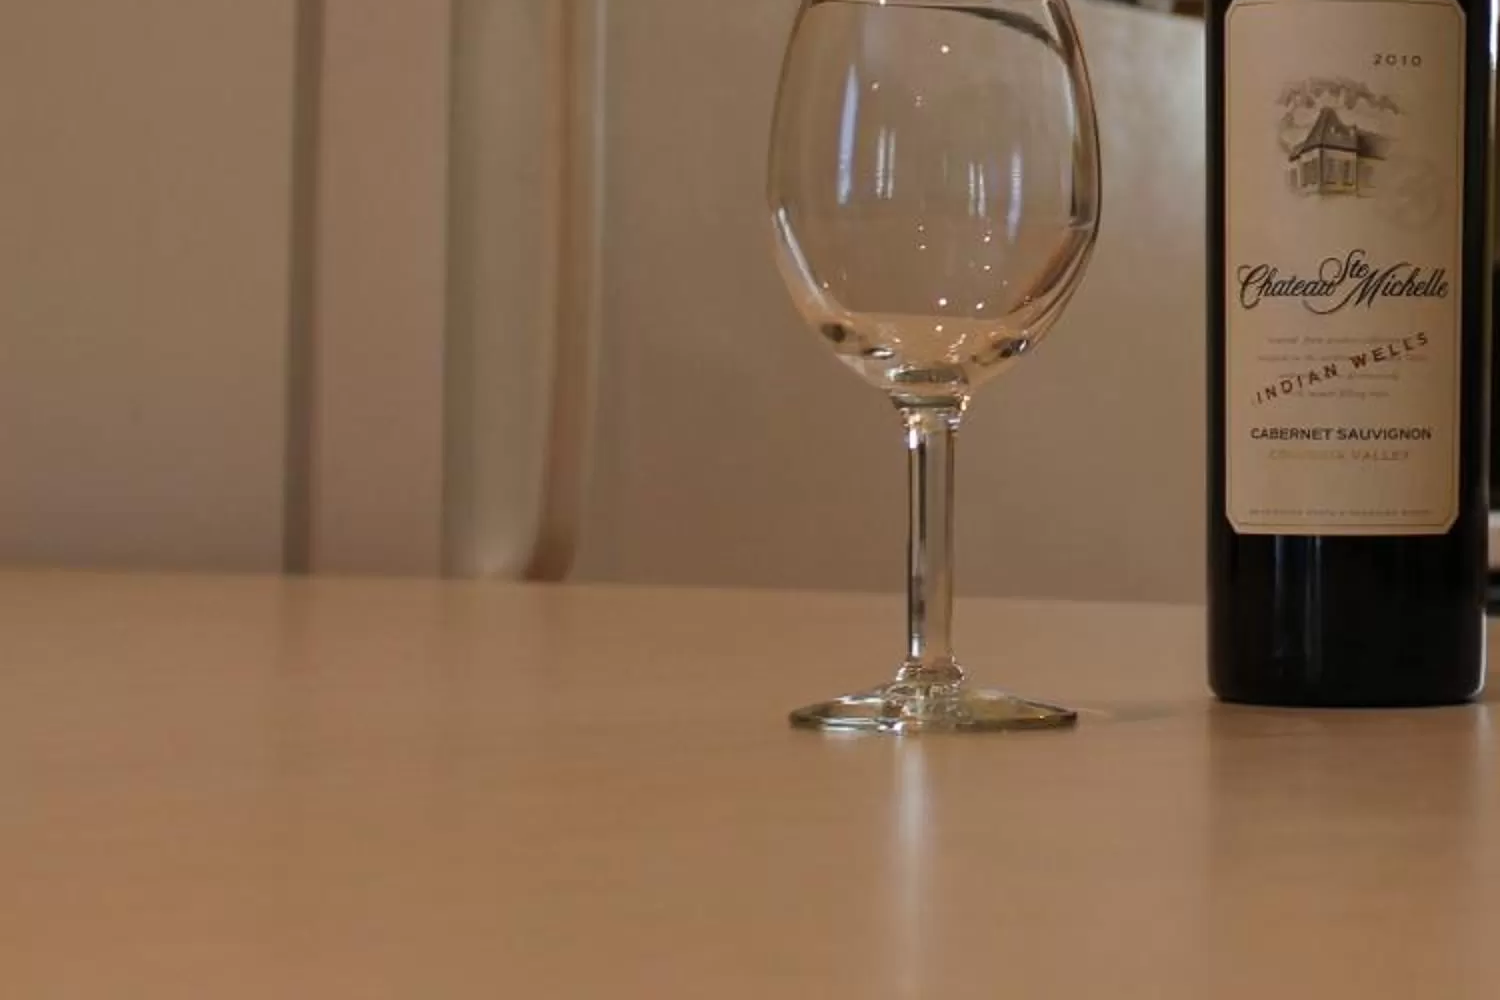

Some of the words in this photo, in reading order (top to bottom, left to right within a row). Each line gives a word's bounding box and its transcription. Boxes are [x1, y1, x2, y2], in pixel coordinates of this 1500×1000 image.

[1373, 53, 1422, 67] 2010
[1237, 264, 1338, 310] Chateau
[1303, 261, 1449, 315] Michelle
[1319, 249, 1370, 287] Ste
[1256, 363, 1338, 404] INDIAN
[1350, 332, 1429, 369] WELLS
[1250, 427, 1332, 441] CABERNET
[1337, 427, 1432, 441] SAUVIGNON
